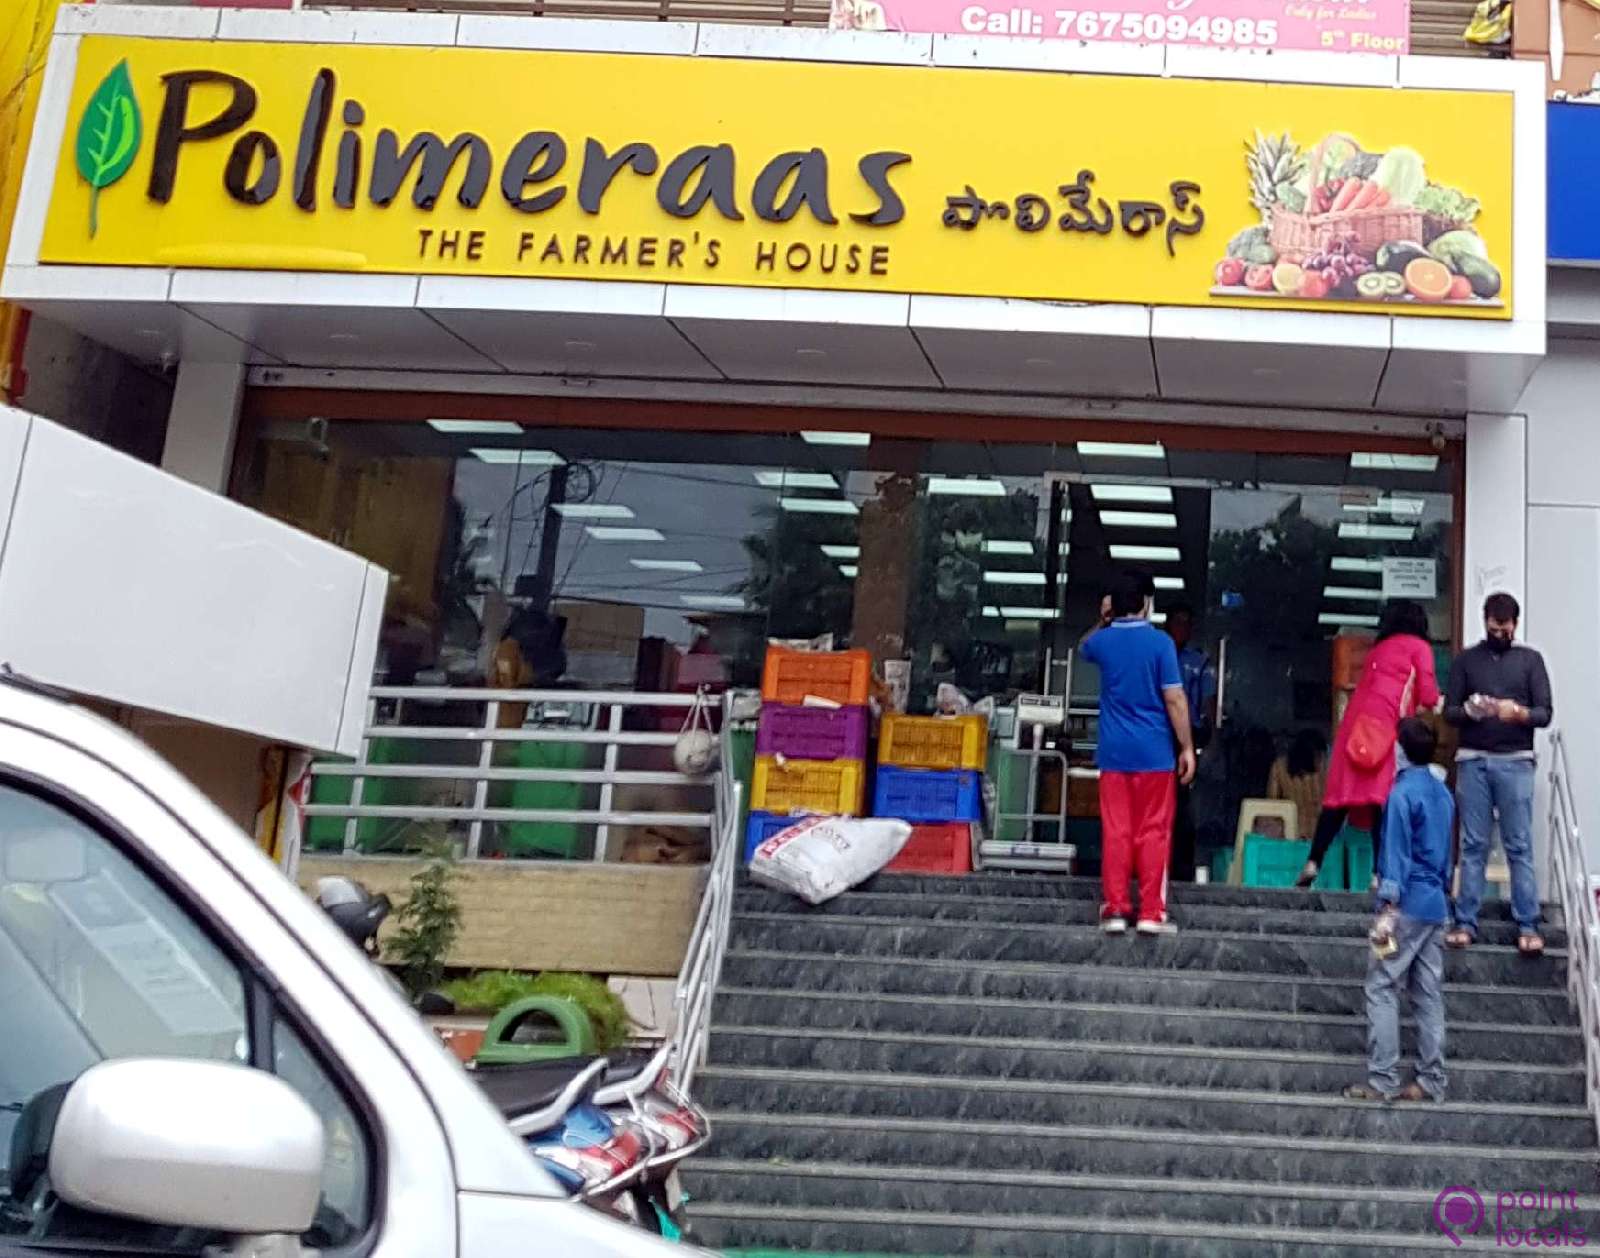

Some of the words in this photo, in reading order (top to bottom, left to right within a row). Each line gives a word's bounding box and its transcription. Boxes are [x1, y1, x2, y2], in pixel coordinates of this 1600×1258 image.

[961, 6, 1044, 35] Call:
[1055, 9, 1278, 46] 7675094985
[1350, 31, 1405, 50] Floor
[147, 67, 912, 226] Polimeraas
[418, 229, 486, 261] THE
[516, 231, 721, 268] FARMER'S
[755, 241, 890, 276] HOUSE
